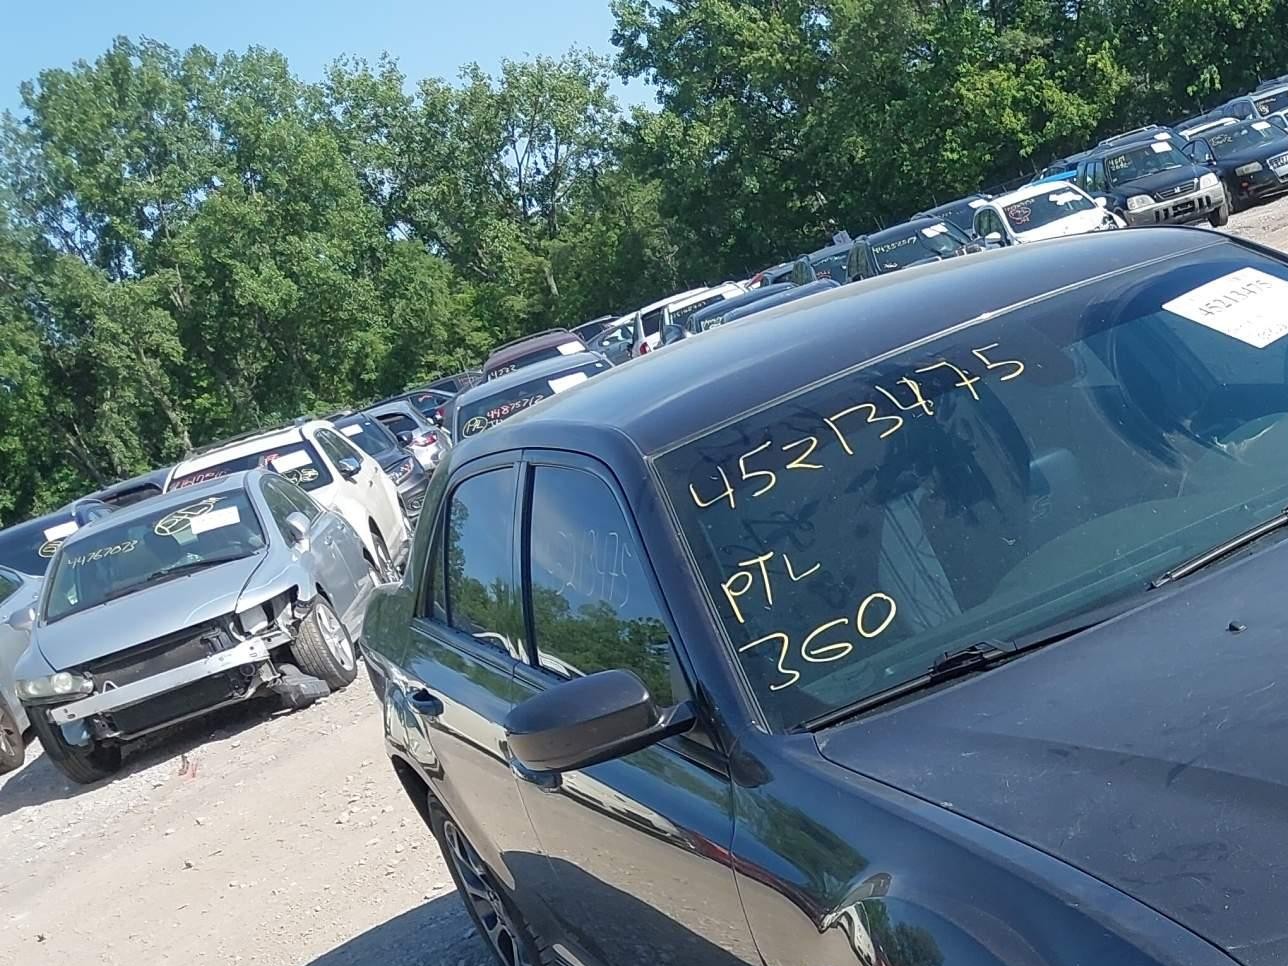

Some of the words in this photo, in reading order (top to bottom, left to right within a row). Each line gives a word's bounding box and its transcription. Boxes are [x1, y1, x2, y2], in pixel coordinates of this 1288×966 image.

[689, 343, 1025, 509] 45213475
[721, 551, 821, 624] PTL
[738, 592, 897, 691] 360
